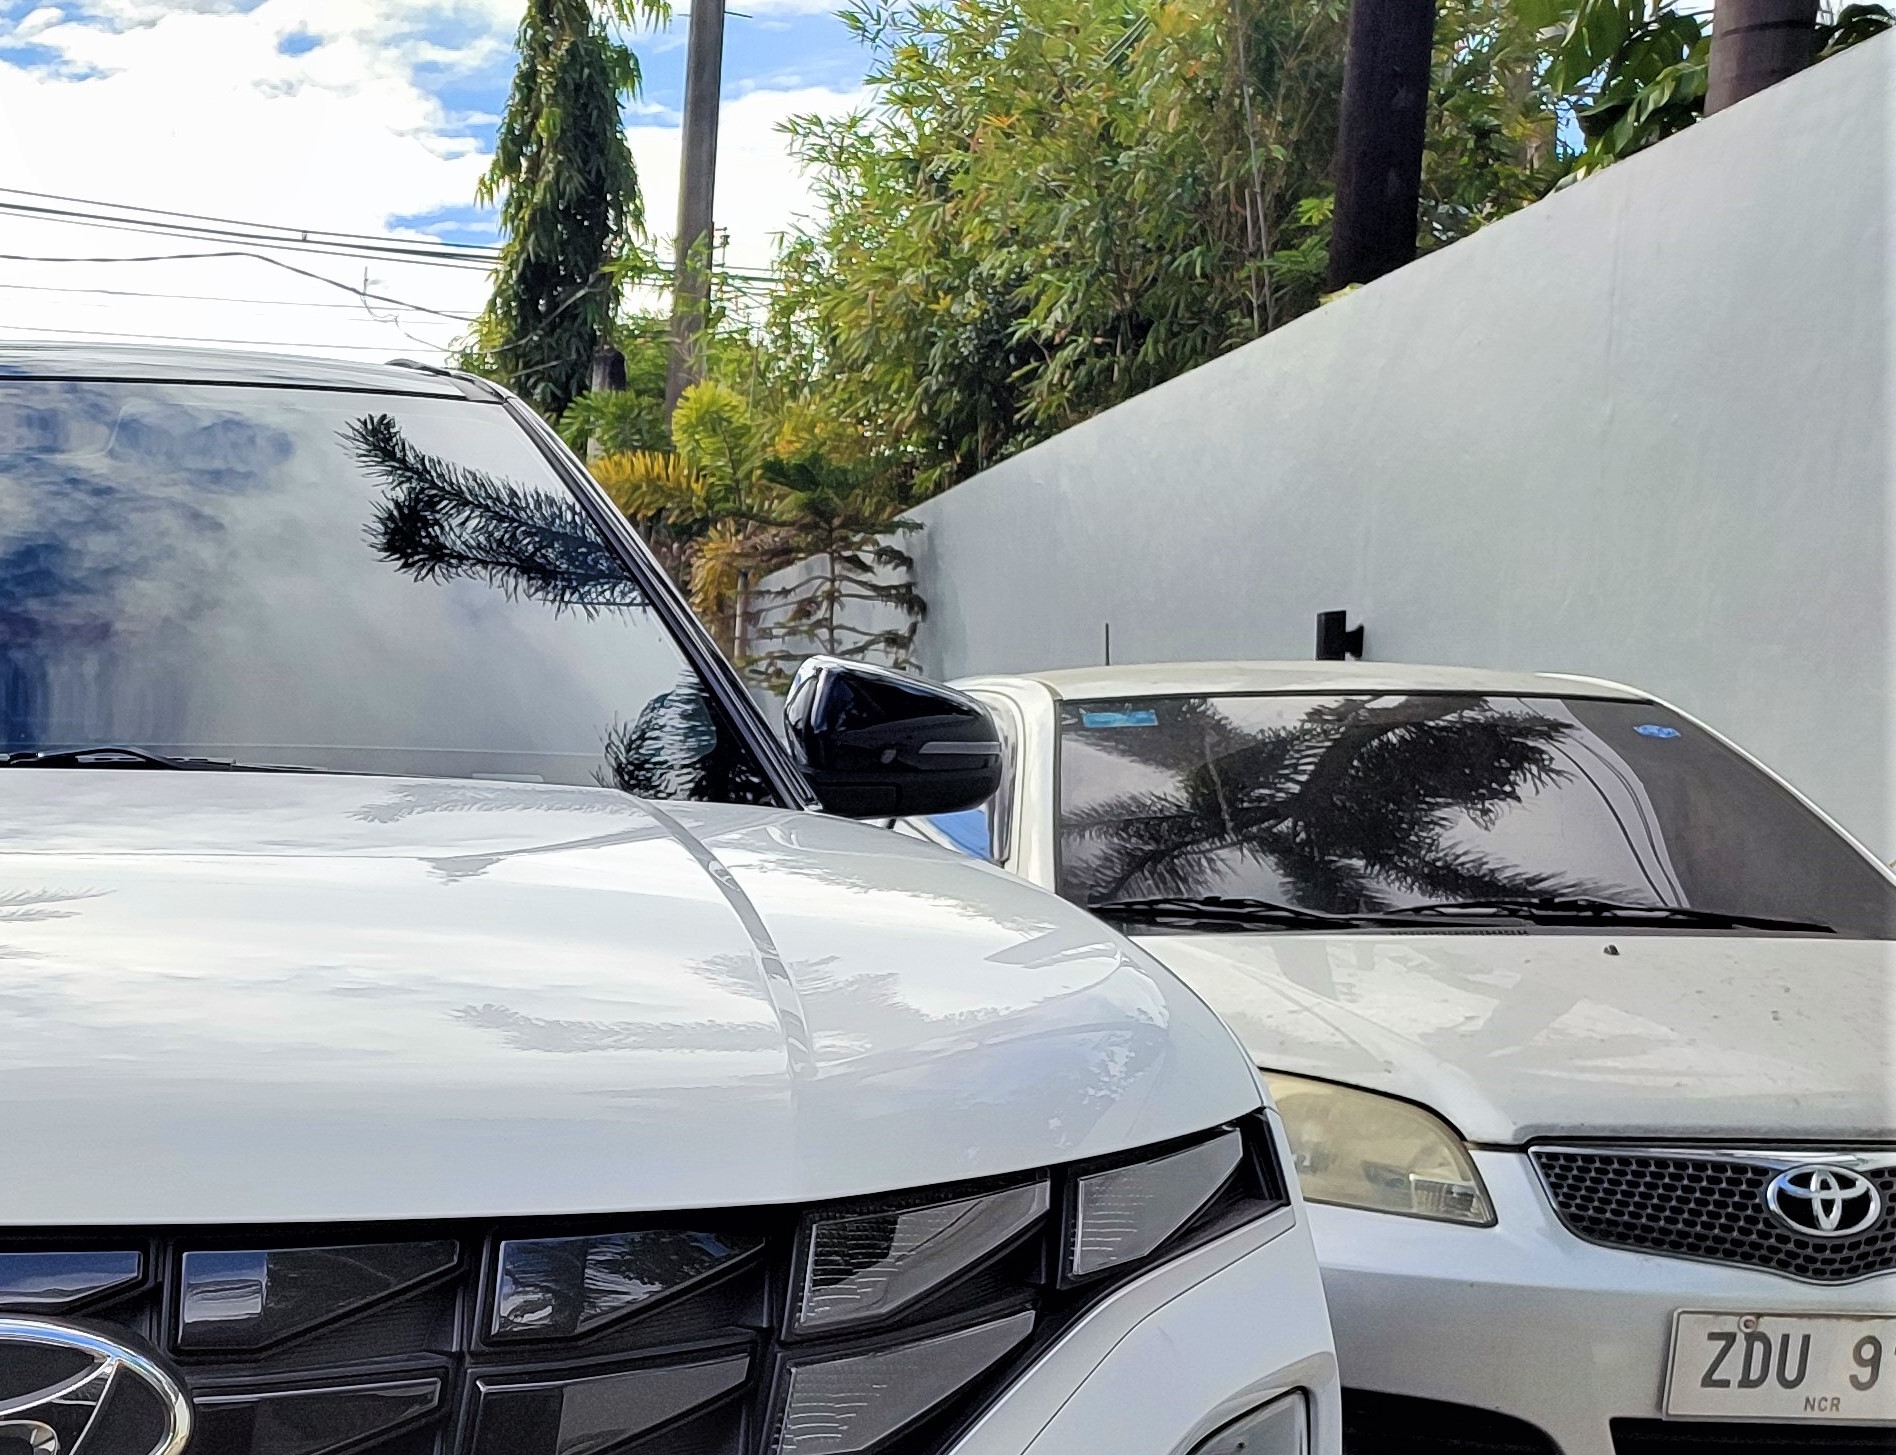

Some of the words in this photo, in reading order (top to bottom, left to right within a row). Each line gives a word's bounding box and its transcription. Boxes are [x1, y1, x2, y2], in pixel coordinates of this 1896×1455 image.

[1700, 1331, 1812, 1390] ZDU
[1849, 1334, 1896, 1392] 9
[1804, 1396, 1841, 1412] NCR
